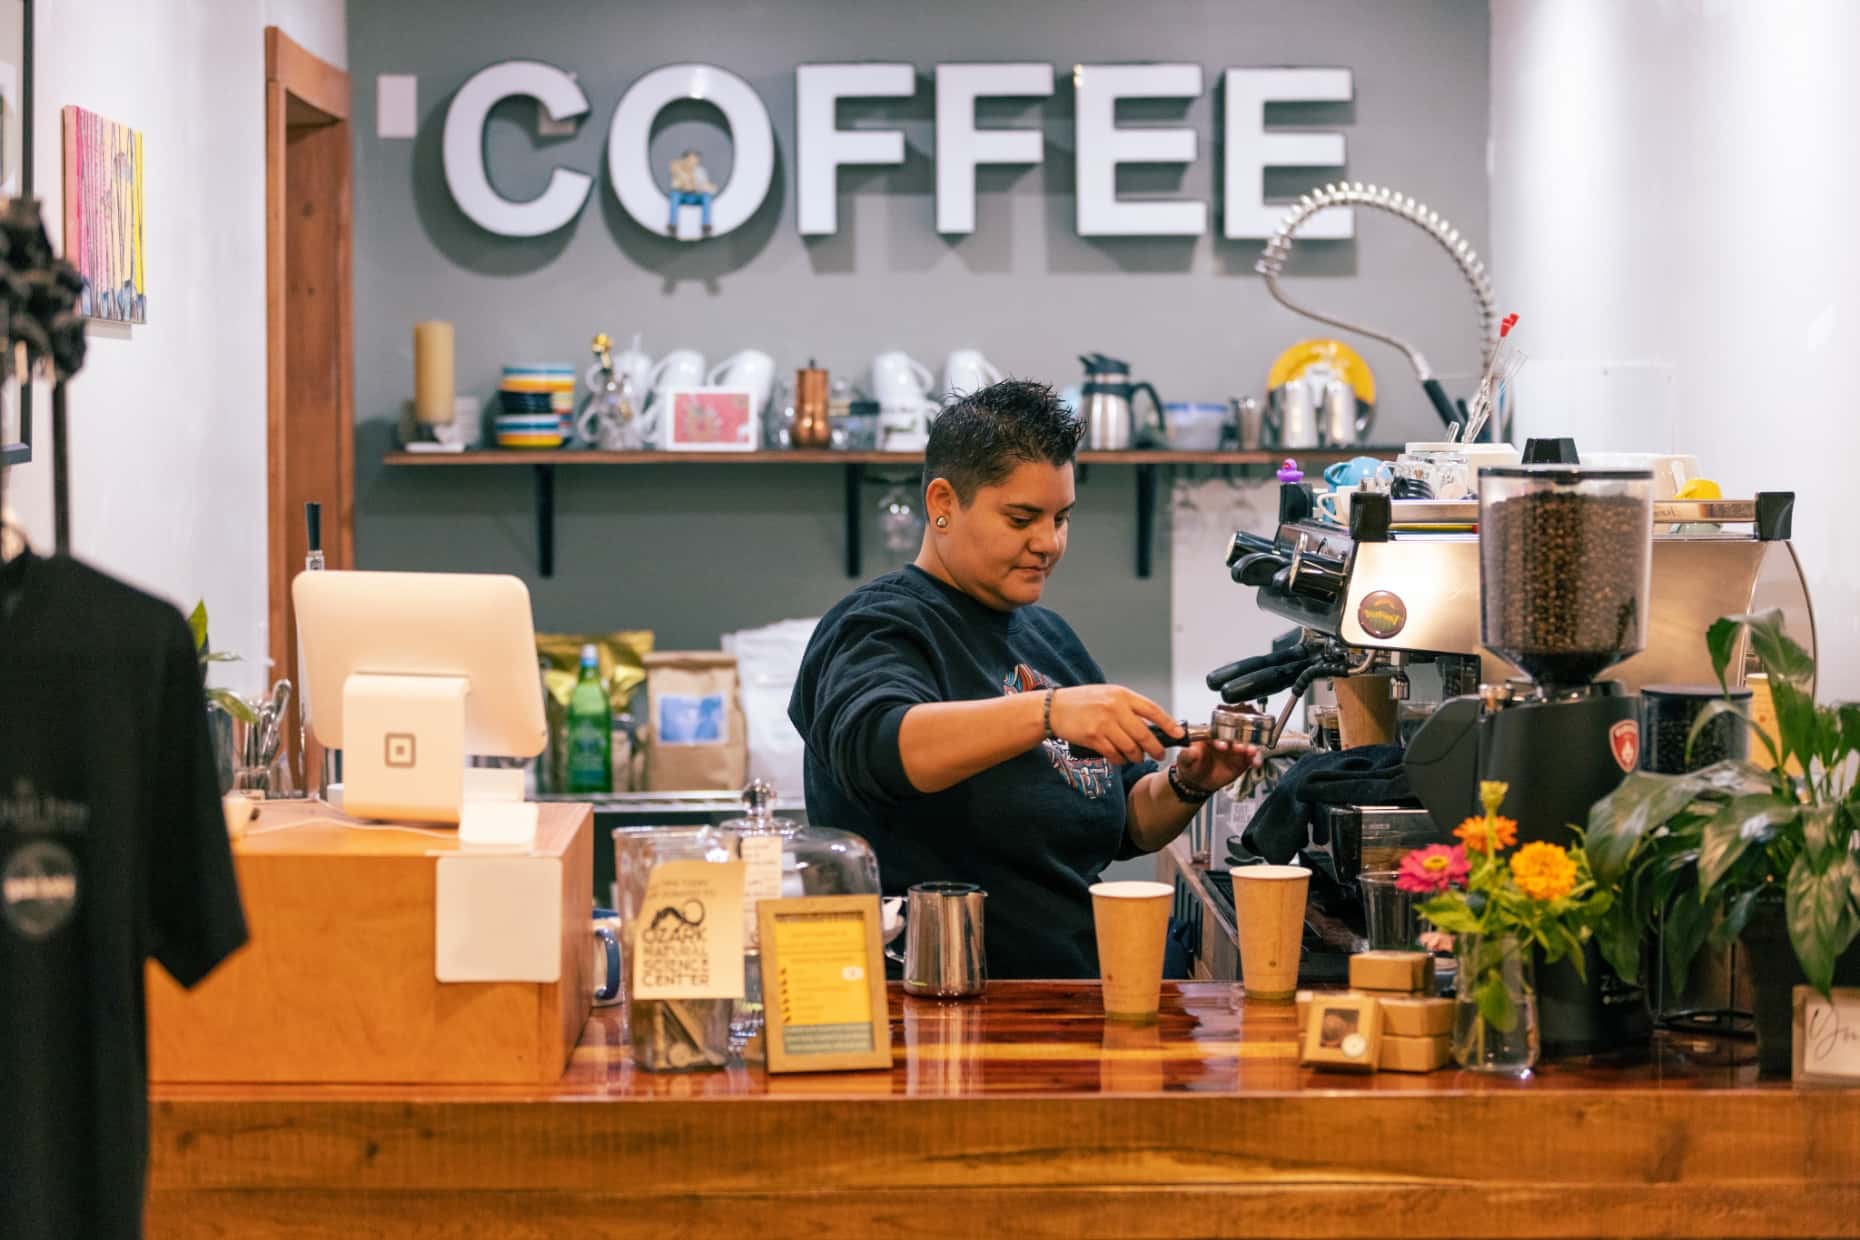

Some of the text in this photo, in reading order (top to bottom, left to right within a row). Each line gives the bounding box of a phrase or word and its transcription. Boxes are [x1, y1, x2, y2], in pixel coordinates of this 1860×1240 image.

[443, 60, 1354, 239] COFFEE
[642, 927, 708, 944] OZARK
[642, 974, 710, 987] CENTER
